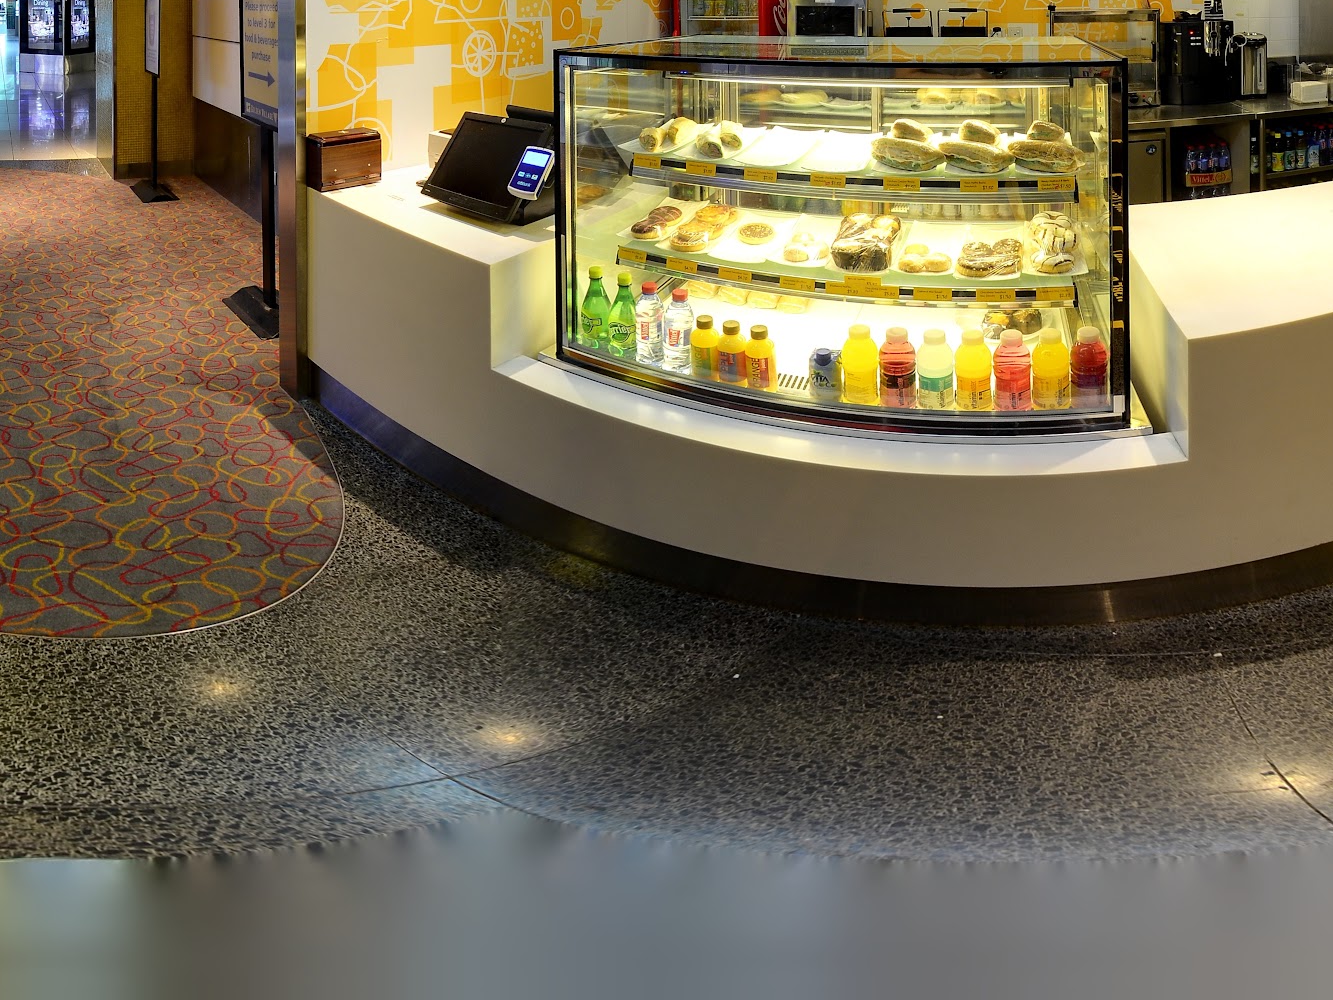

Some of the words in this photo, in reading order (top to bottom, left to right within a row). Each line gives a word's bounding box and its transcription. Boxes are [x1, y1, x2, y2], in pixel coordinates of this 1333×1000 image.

[245, 1, 259, 11] Please
[259, 1, 278, 12] proceed
[247, 18, 252, 26] to
[253, 18, 263, 27] level
[264, 19, 268, 27] 3
[245, 32, 253, 42] food
[251, 51, 271, 62] purchase
[751, 357, 761, 388] ORANGE
